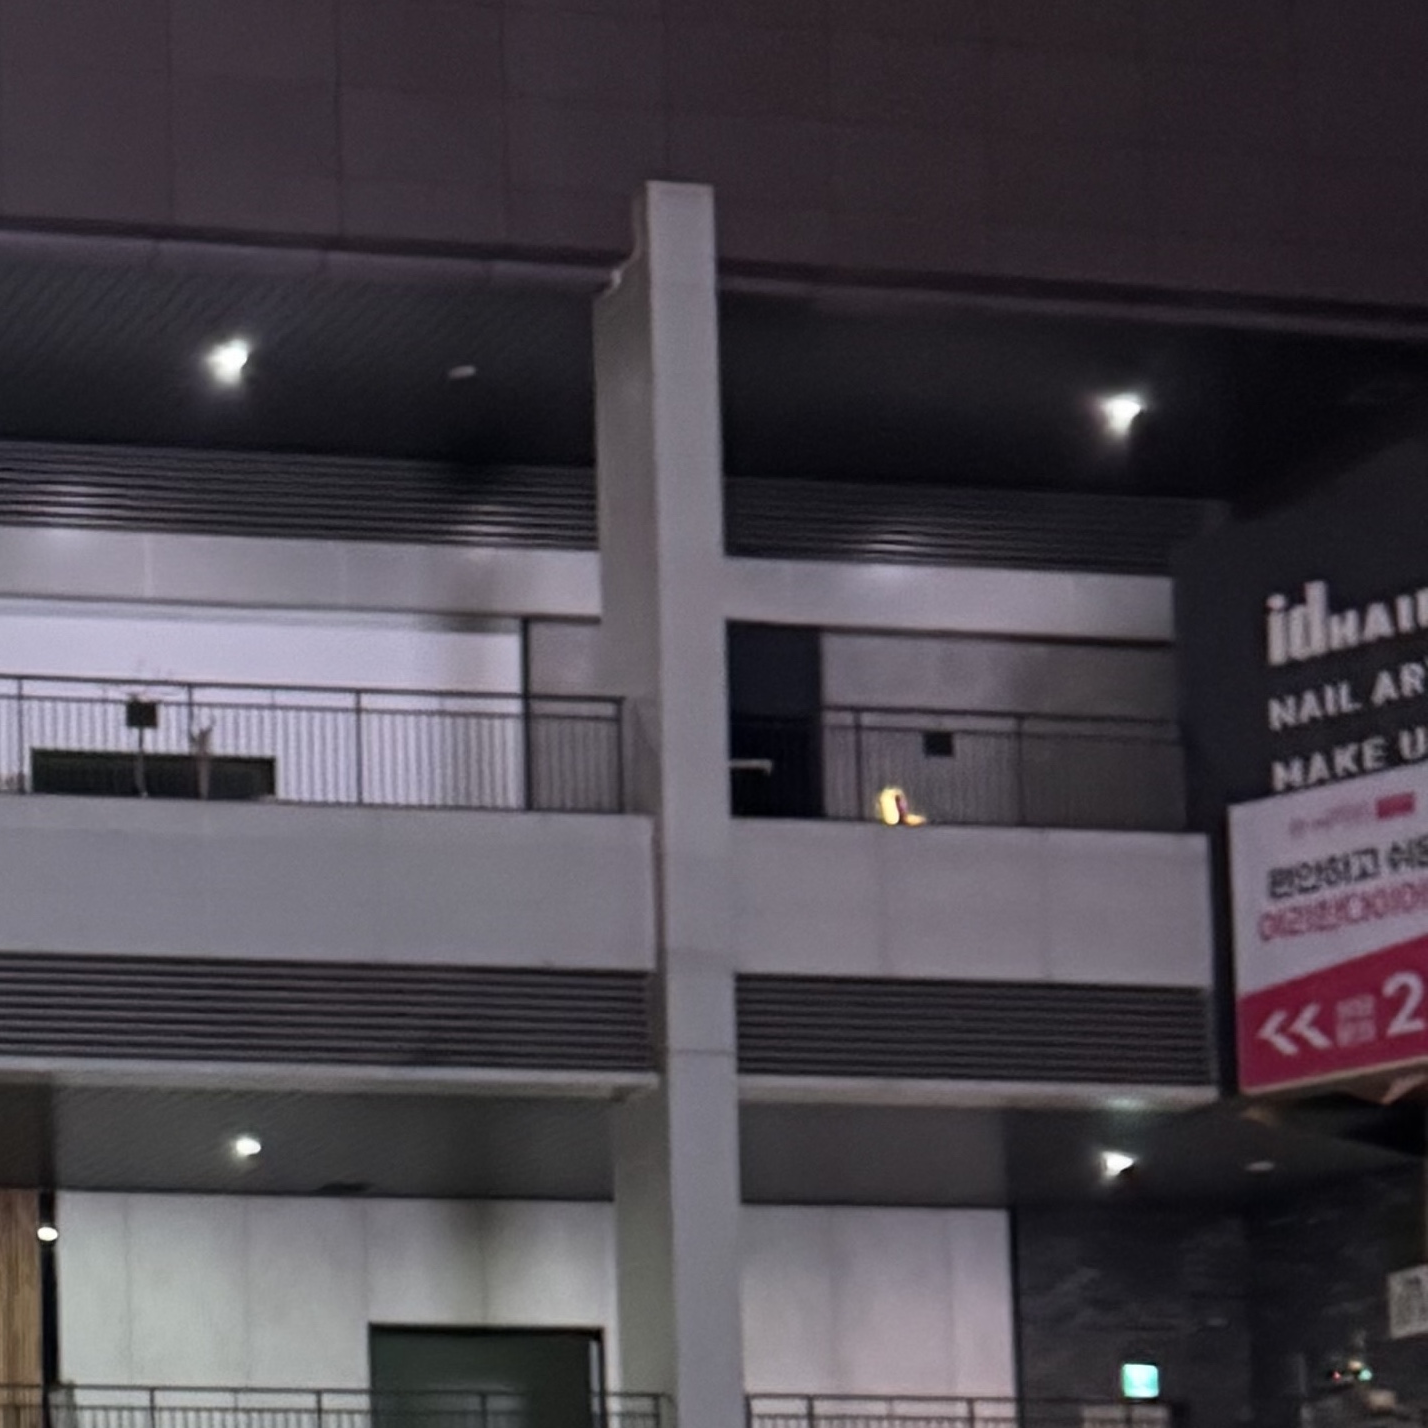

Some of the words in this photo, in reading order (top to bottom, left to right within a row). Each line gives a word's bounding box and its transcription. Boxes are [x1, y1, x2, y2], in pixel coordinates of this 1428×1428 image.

[1268, 681, 1363, 732] NAIL
[1370, 655, 1428, 707] AR
[1271, 735, 1388, 792] MAKE
